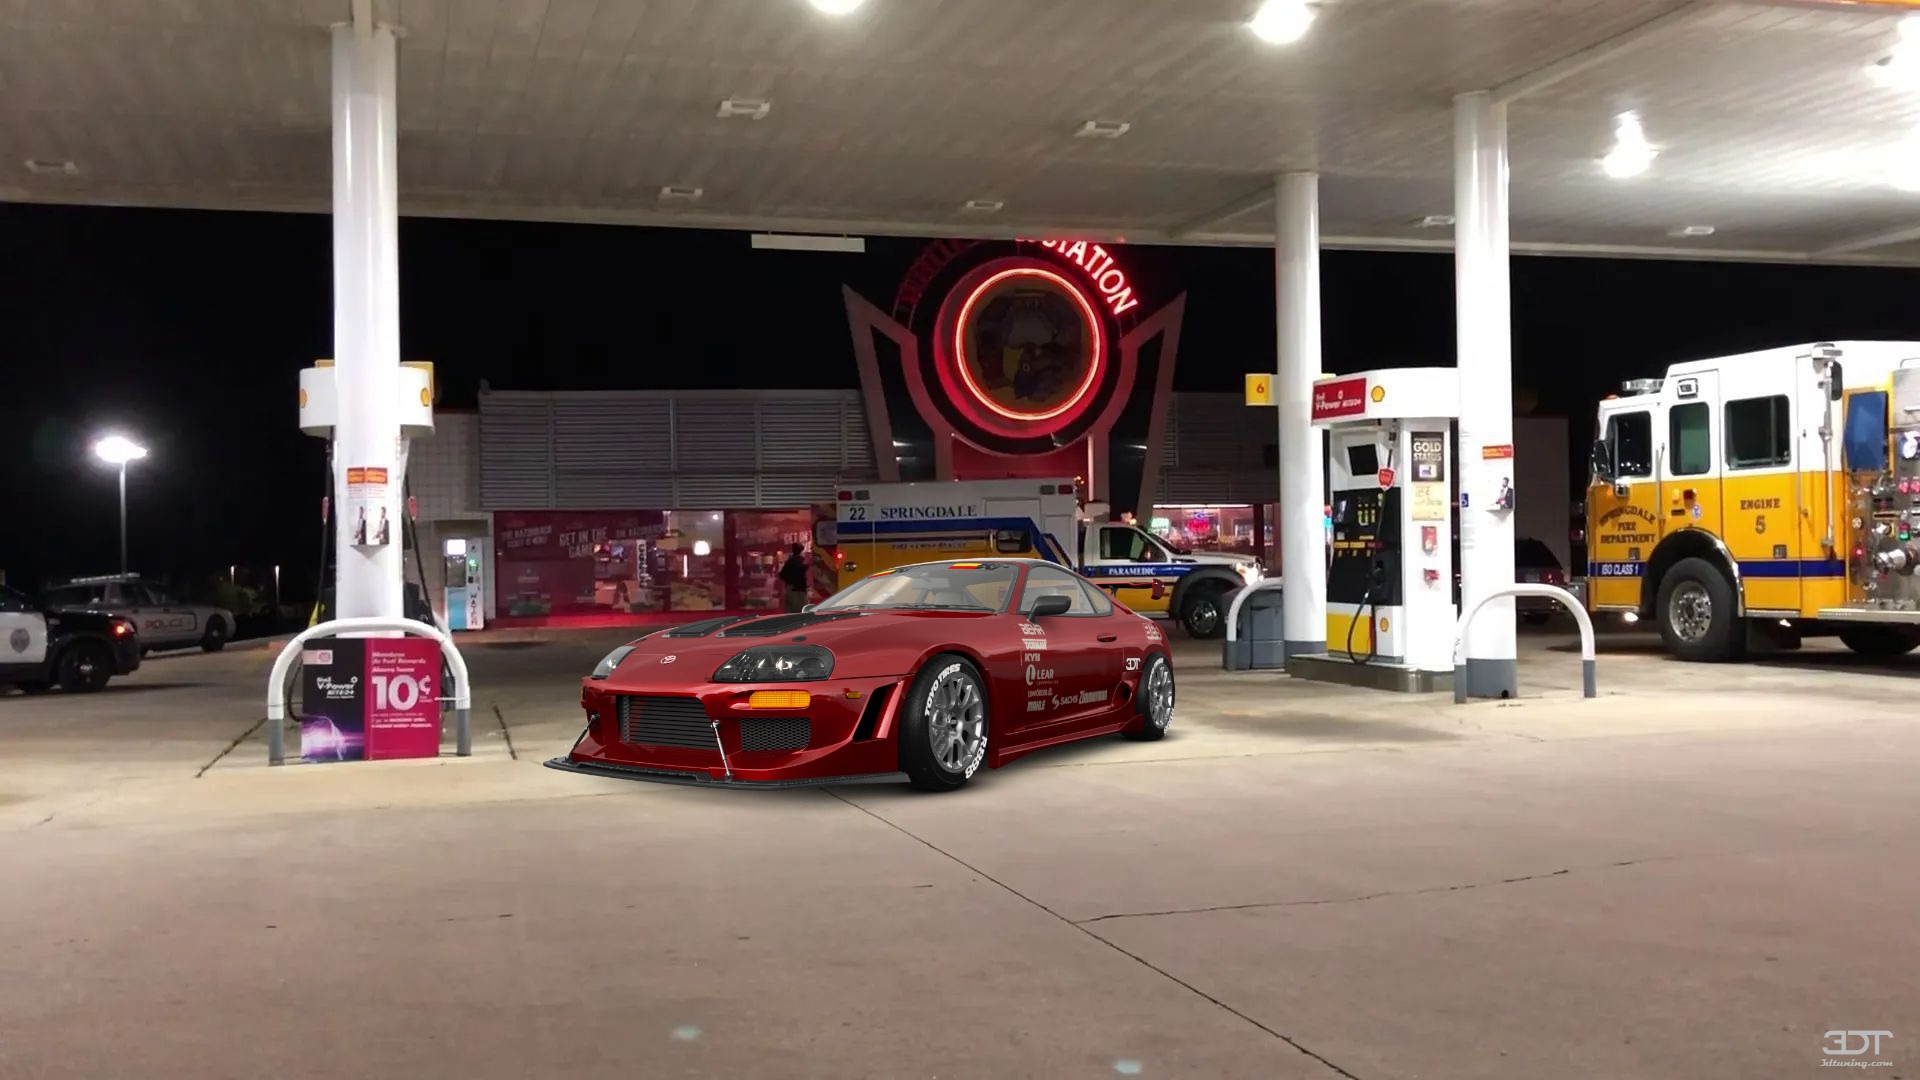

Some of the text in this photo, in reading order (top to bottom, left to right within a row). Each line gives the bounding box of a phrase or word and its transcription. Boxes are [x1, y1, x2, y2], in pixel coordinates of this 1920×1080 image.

[1256, 383, 1265, 394] 6
[1413, 442, 1441, 453] GOLD
[1413, 452, 1442, 461] STATUS
[1740, 498, 1780, 510] ENGINE
[849, 507, 865, 520] 22
[880, 505, 977, 519] SPRINGDALE
[1599, 505, 1657, 527] SPRINGDALE
[1618, 521, 1636, 531] FIRE
[1755, 515, 1766, 534] 5
[559, 530, 577, 547] GET
[578, 531, 589, 543] IN
[1600, 533, 1656, 544] DEPARTMENT
[1109, 567, 1156, 576] PARAMEDIC
[1601, 564, 1613, 575] ISO
[1613, 564, 1634, 575] CLASS
[144, 618, 183, 630] POLICE
[1019, 623, 1046, 636] BEHR
[1125, 657, 1141, 671] 3DT
[938, 663, 961, 683] TIRES
[1036, 669, 1054, 680] LEAR
[317, 682, 355, 690] V-Power
[924, 679, 939, 717] TOYO
[1060, 695, 1079, 706] SACHS
[965, 736, 988, 779] R888
